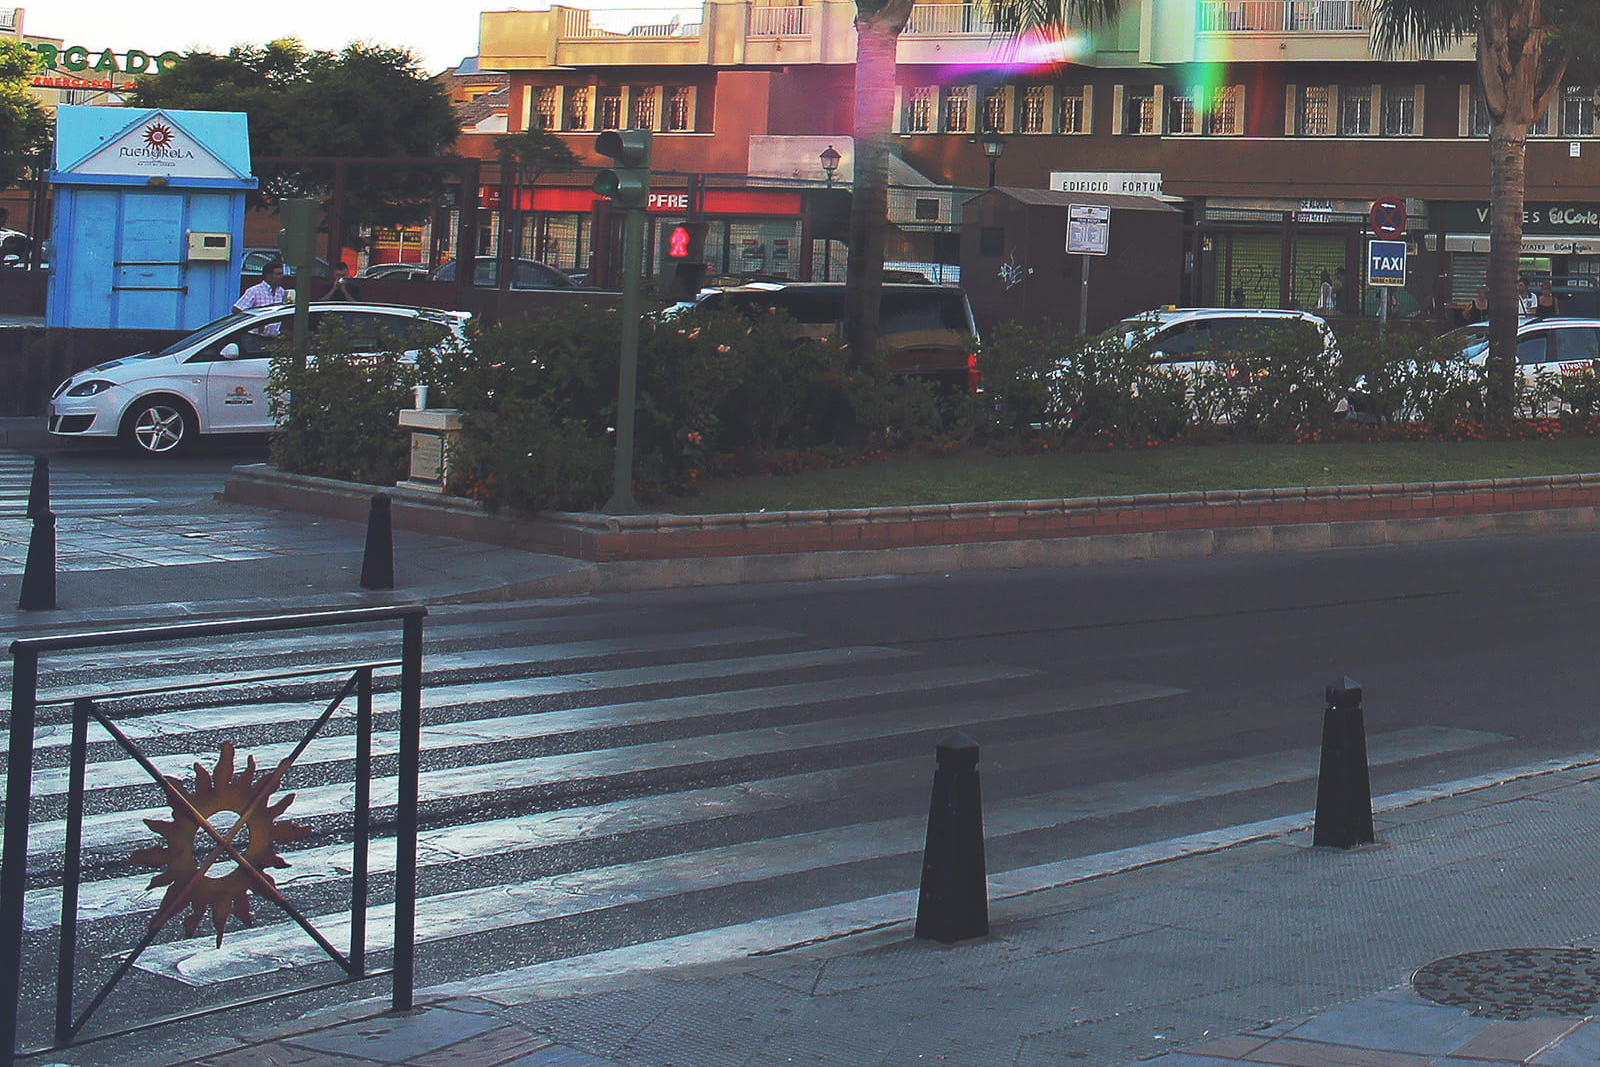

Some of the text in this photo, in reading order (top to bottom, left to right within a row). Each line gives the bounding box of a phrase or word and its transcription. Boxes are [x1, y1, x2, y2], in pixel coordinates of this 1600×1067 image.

[20, 42, 184, 74] RCADO
[1063, 181, 1109, 192] EDIFICIO
[648, 194, 689, 208] PFRE
[1372, 256, 1404, 271] TAXI
